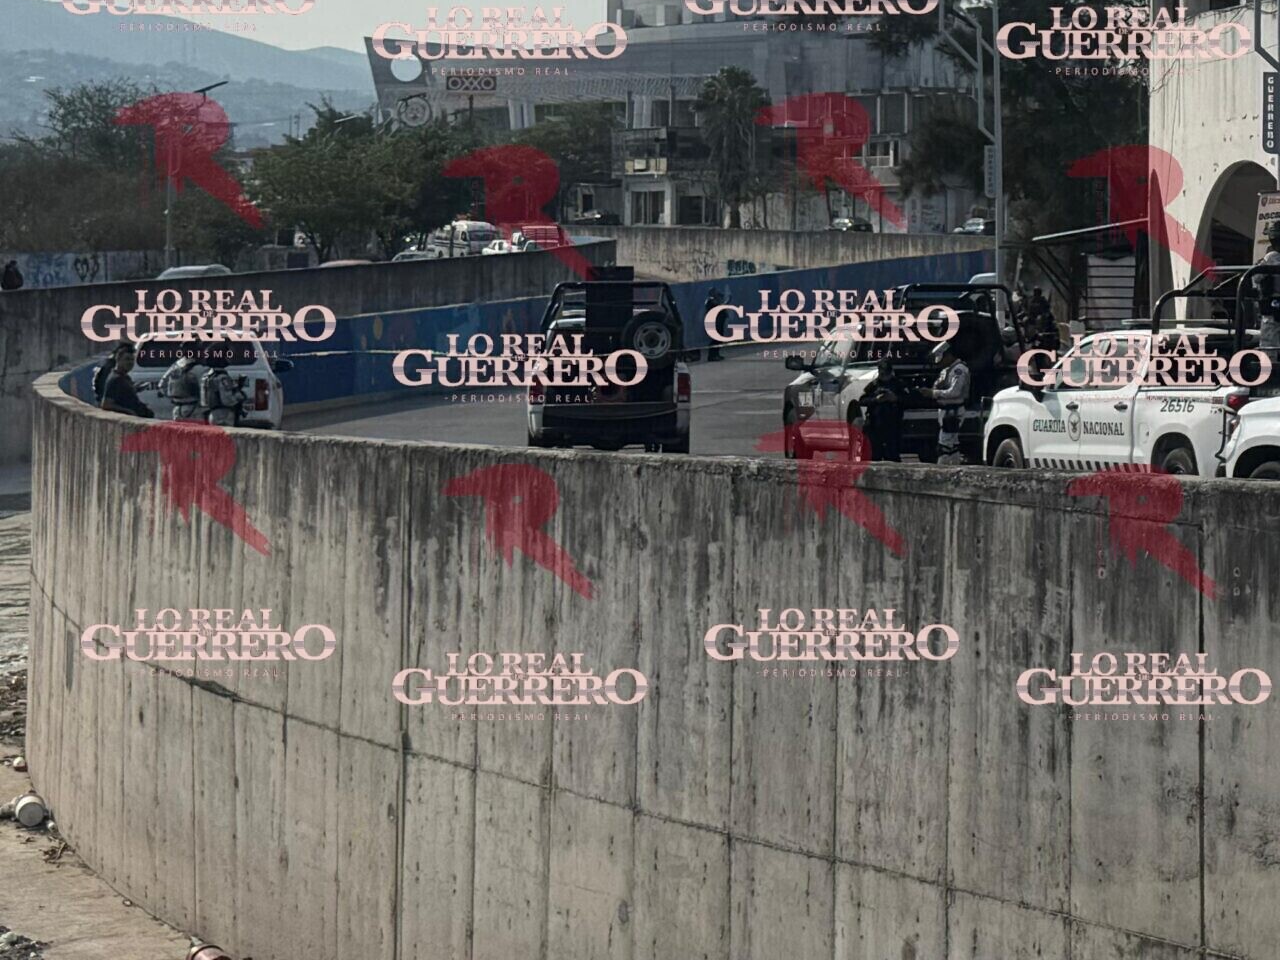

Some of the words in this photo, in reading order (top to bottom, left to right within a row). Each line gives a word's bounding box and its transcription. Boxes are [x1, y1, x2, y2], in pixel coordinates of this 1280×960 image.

[448, 77, 495, 90] OXXO
[1266, 76, 1275, 149] GUERRERO
[1160, 399, 1195, 413] 26516
[1032, 419, 1066, 433] GUARDIA
[1083, 421, 1125, 436] NACIONAL
